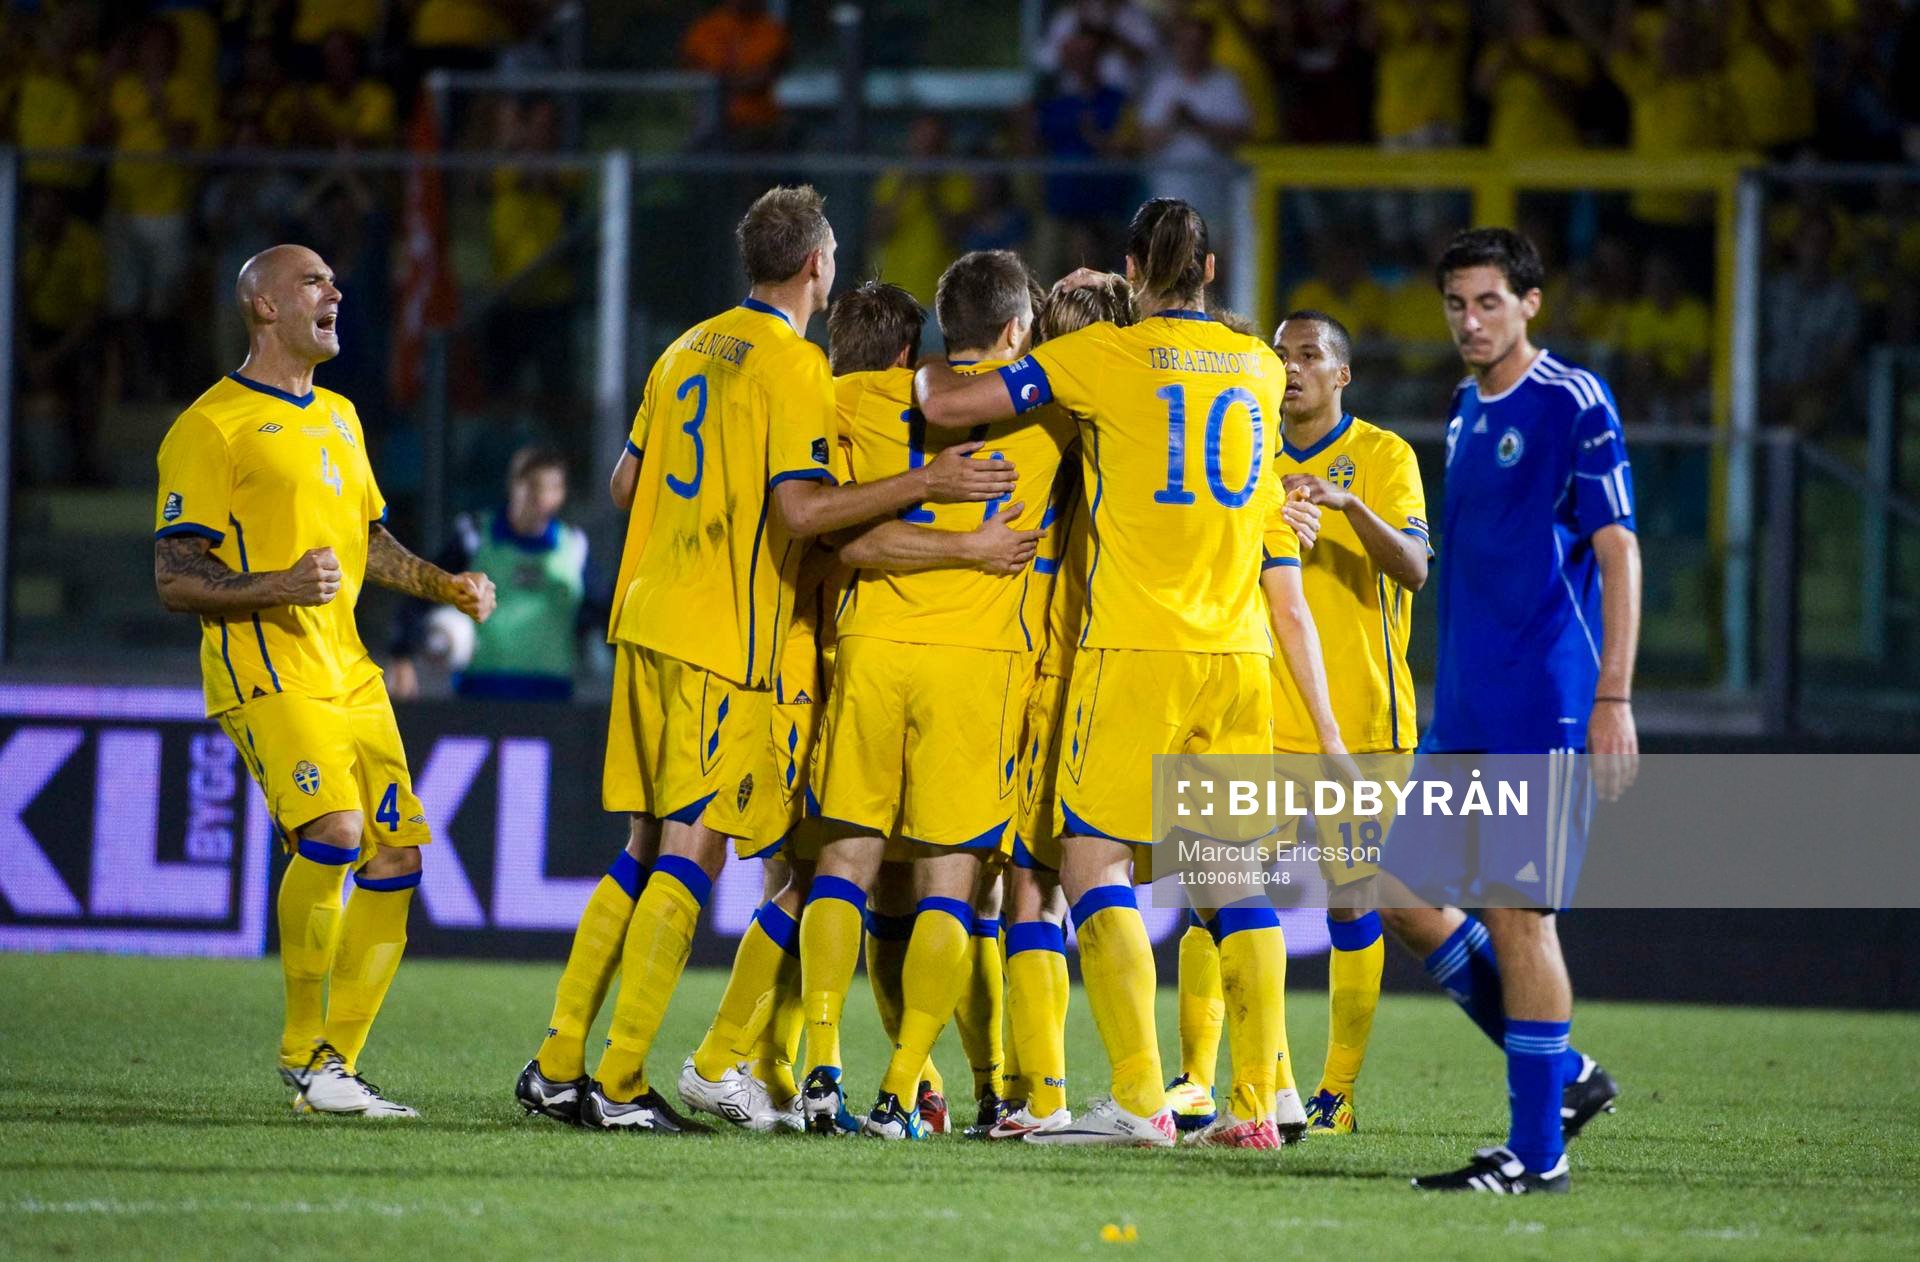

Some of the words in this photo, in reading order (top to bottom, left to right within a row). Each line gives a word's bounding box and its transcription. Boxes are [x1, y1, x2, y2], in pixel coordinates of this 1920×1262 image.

[321, 447, 343, 496] 4
[666, 374, 708, 500] 3
[1154, 384, 1263, 508] 10
[186, 733, 237, 862] BYGG
[376, 783, 400, 832] 4
[1338, 821, 1384, 869] 18
